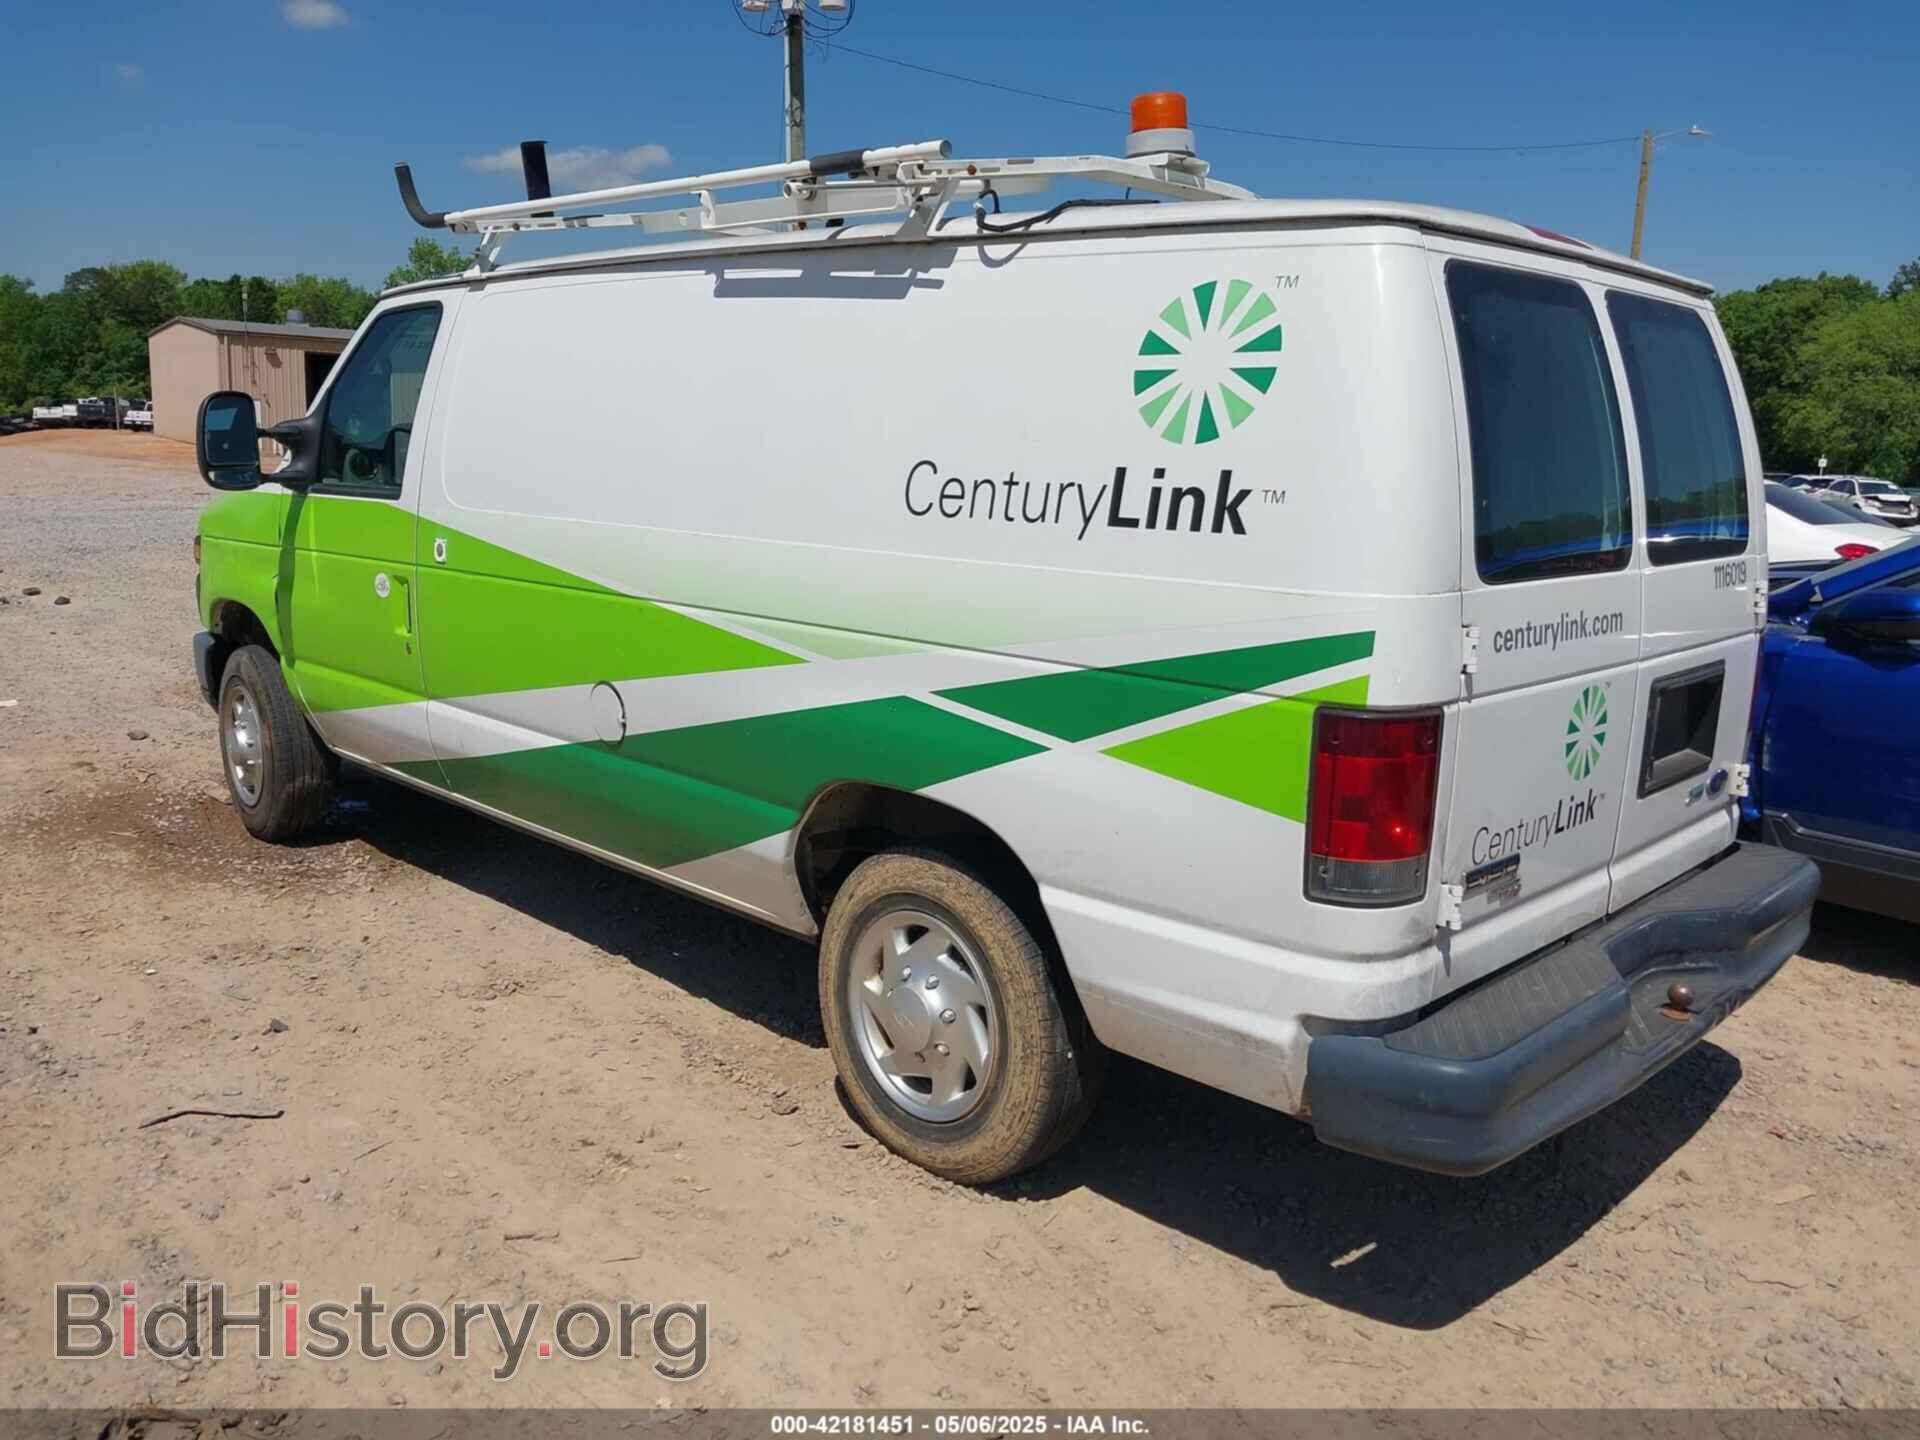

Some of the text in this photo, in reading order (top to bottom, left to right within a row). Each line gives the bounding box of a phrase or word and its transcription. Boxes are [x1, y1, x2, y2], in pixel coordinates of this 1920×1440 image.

[1275, 274, 1300, 289] TM
[905, 459, 1286, 541] CenturyLink TM
[1713, 561, 1747, 590] 1116019
[1493, 609, 1623, 653] centurylink.com
[1472, 788, 1597, 865] CenturyLink
